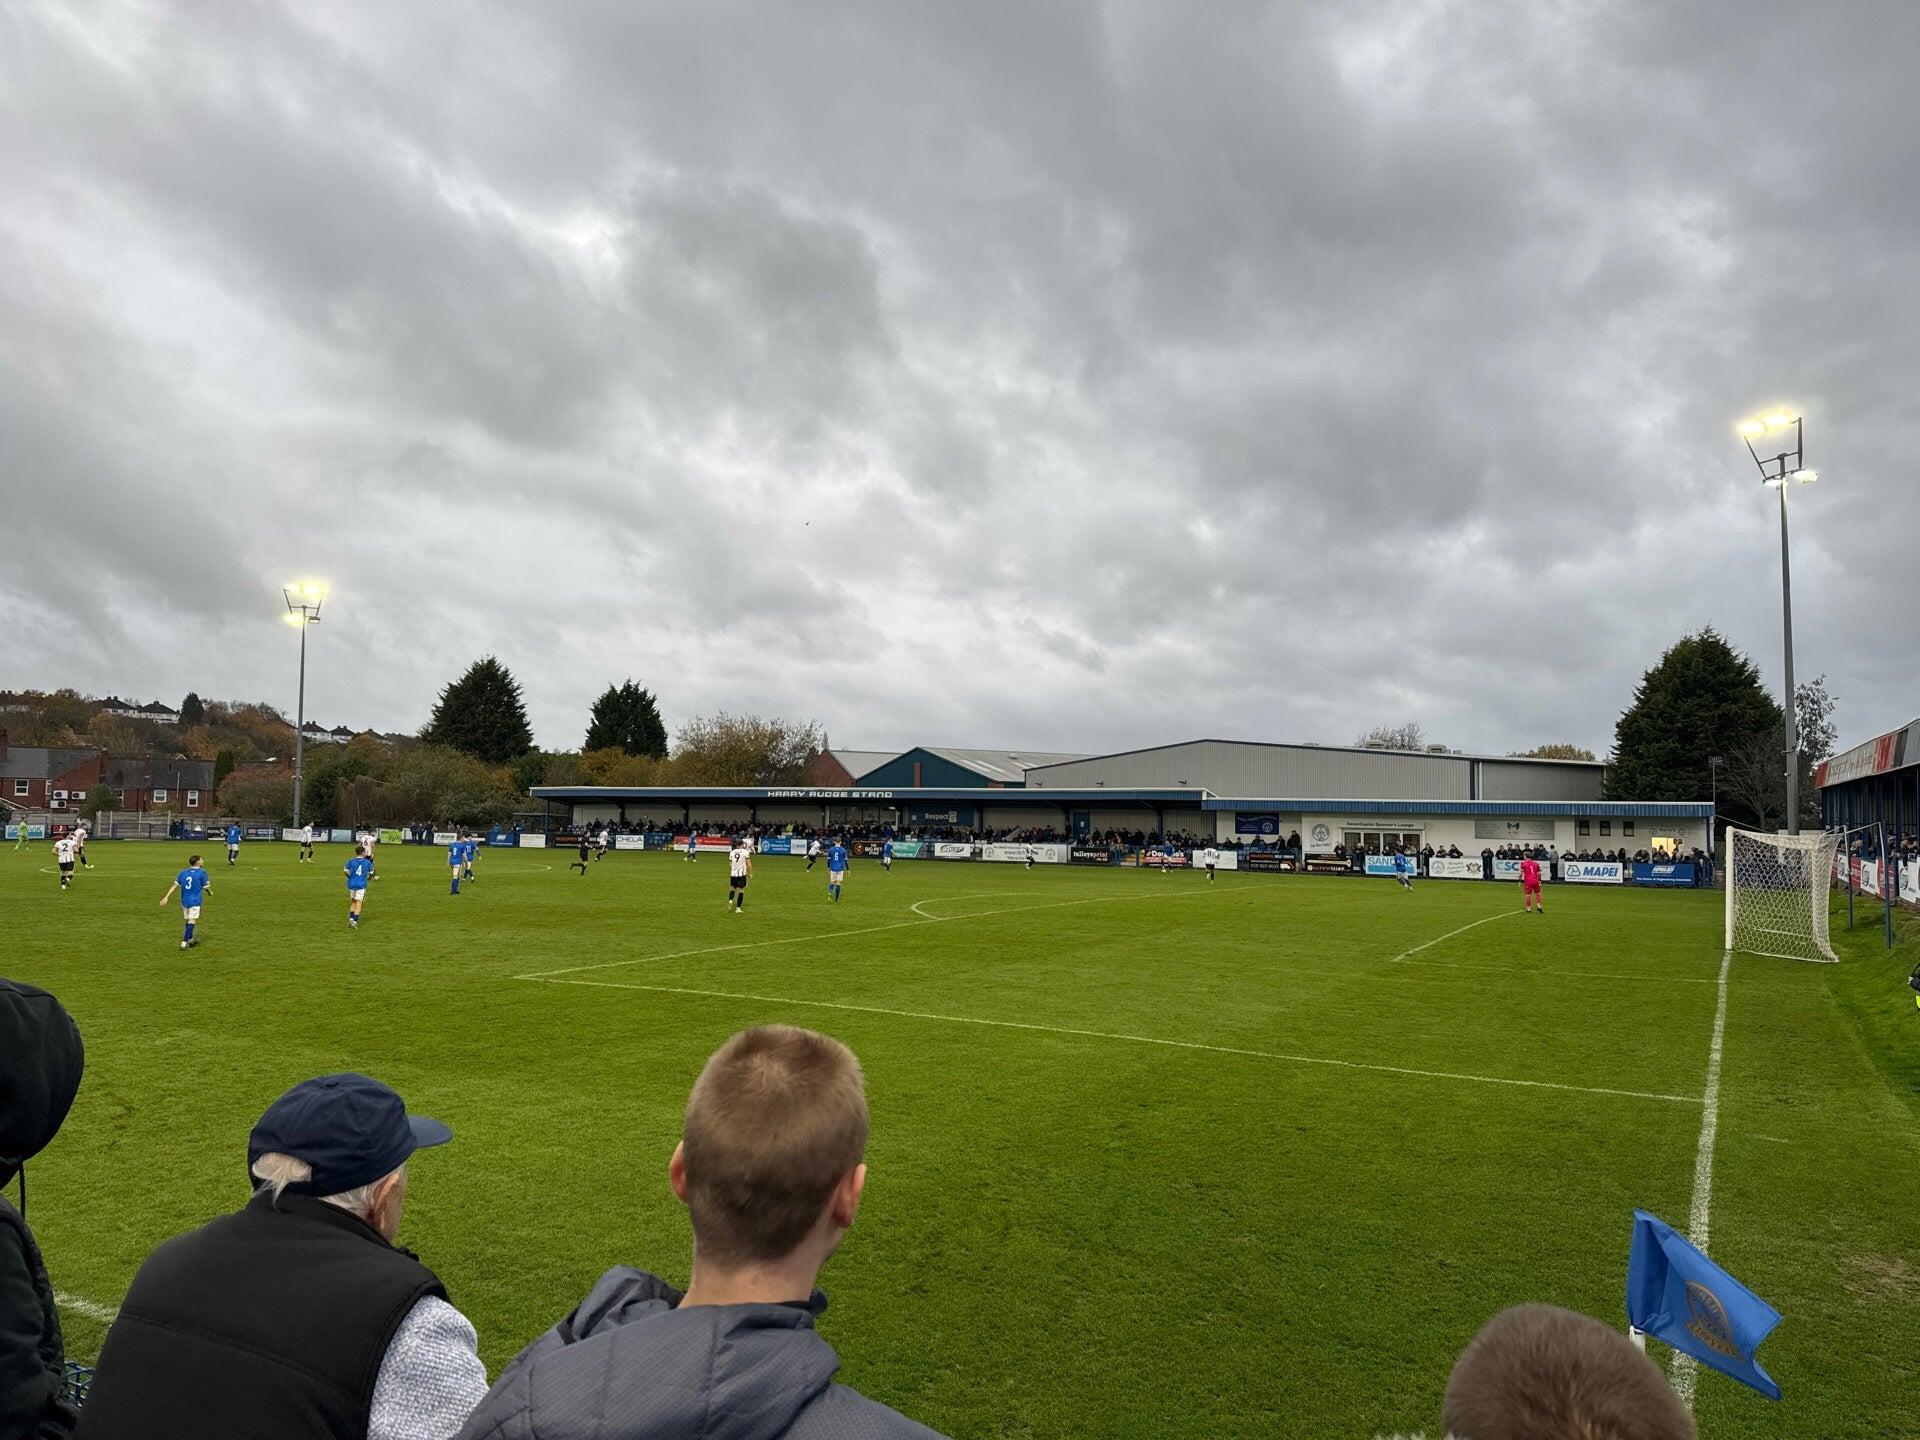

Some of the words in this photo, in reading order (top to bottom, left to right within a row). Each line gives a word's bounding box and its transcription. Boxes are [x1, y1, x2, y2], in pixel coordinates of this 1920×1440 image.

[924, 812, 949, 821] Respect
[61, 843, 68, 852] 2
[734, 853, 741, 863] 9
[834, 852, 839, 861] 6
[1368, 857, 1413, 867] SANDK
[355, 865, 362, 877] 4
[1529, 866, 1534, 874] 1
[1582, 866, 1619, 877] MAPEI
[185, 876, 193, 890] 3
